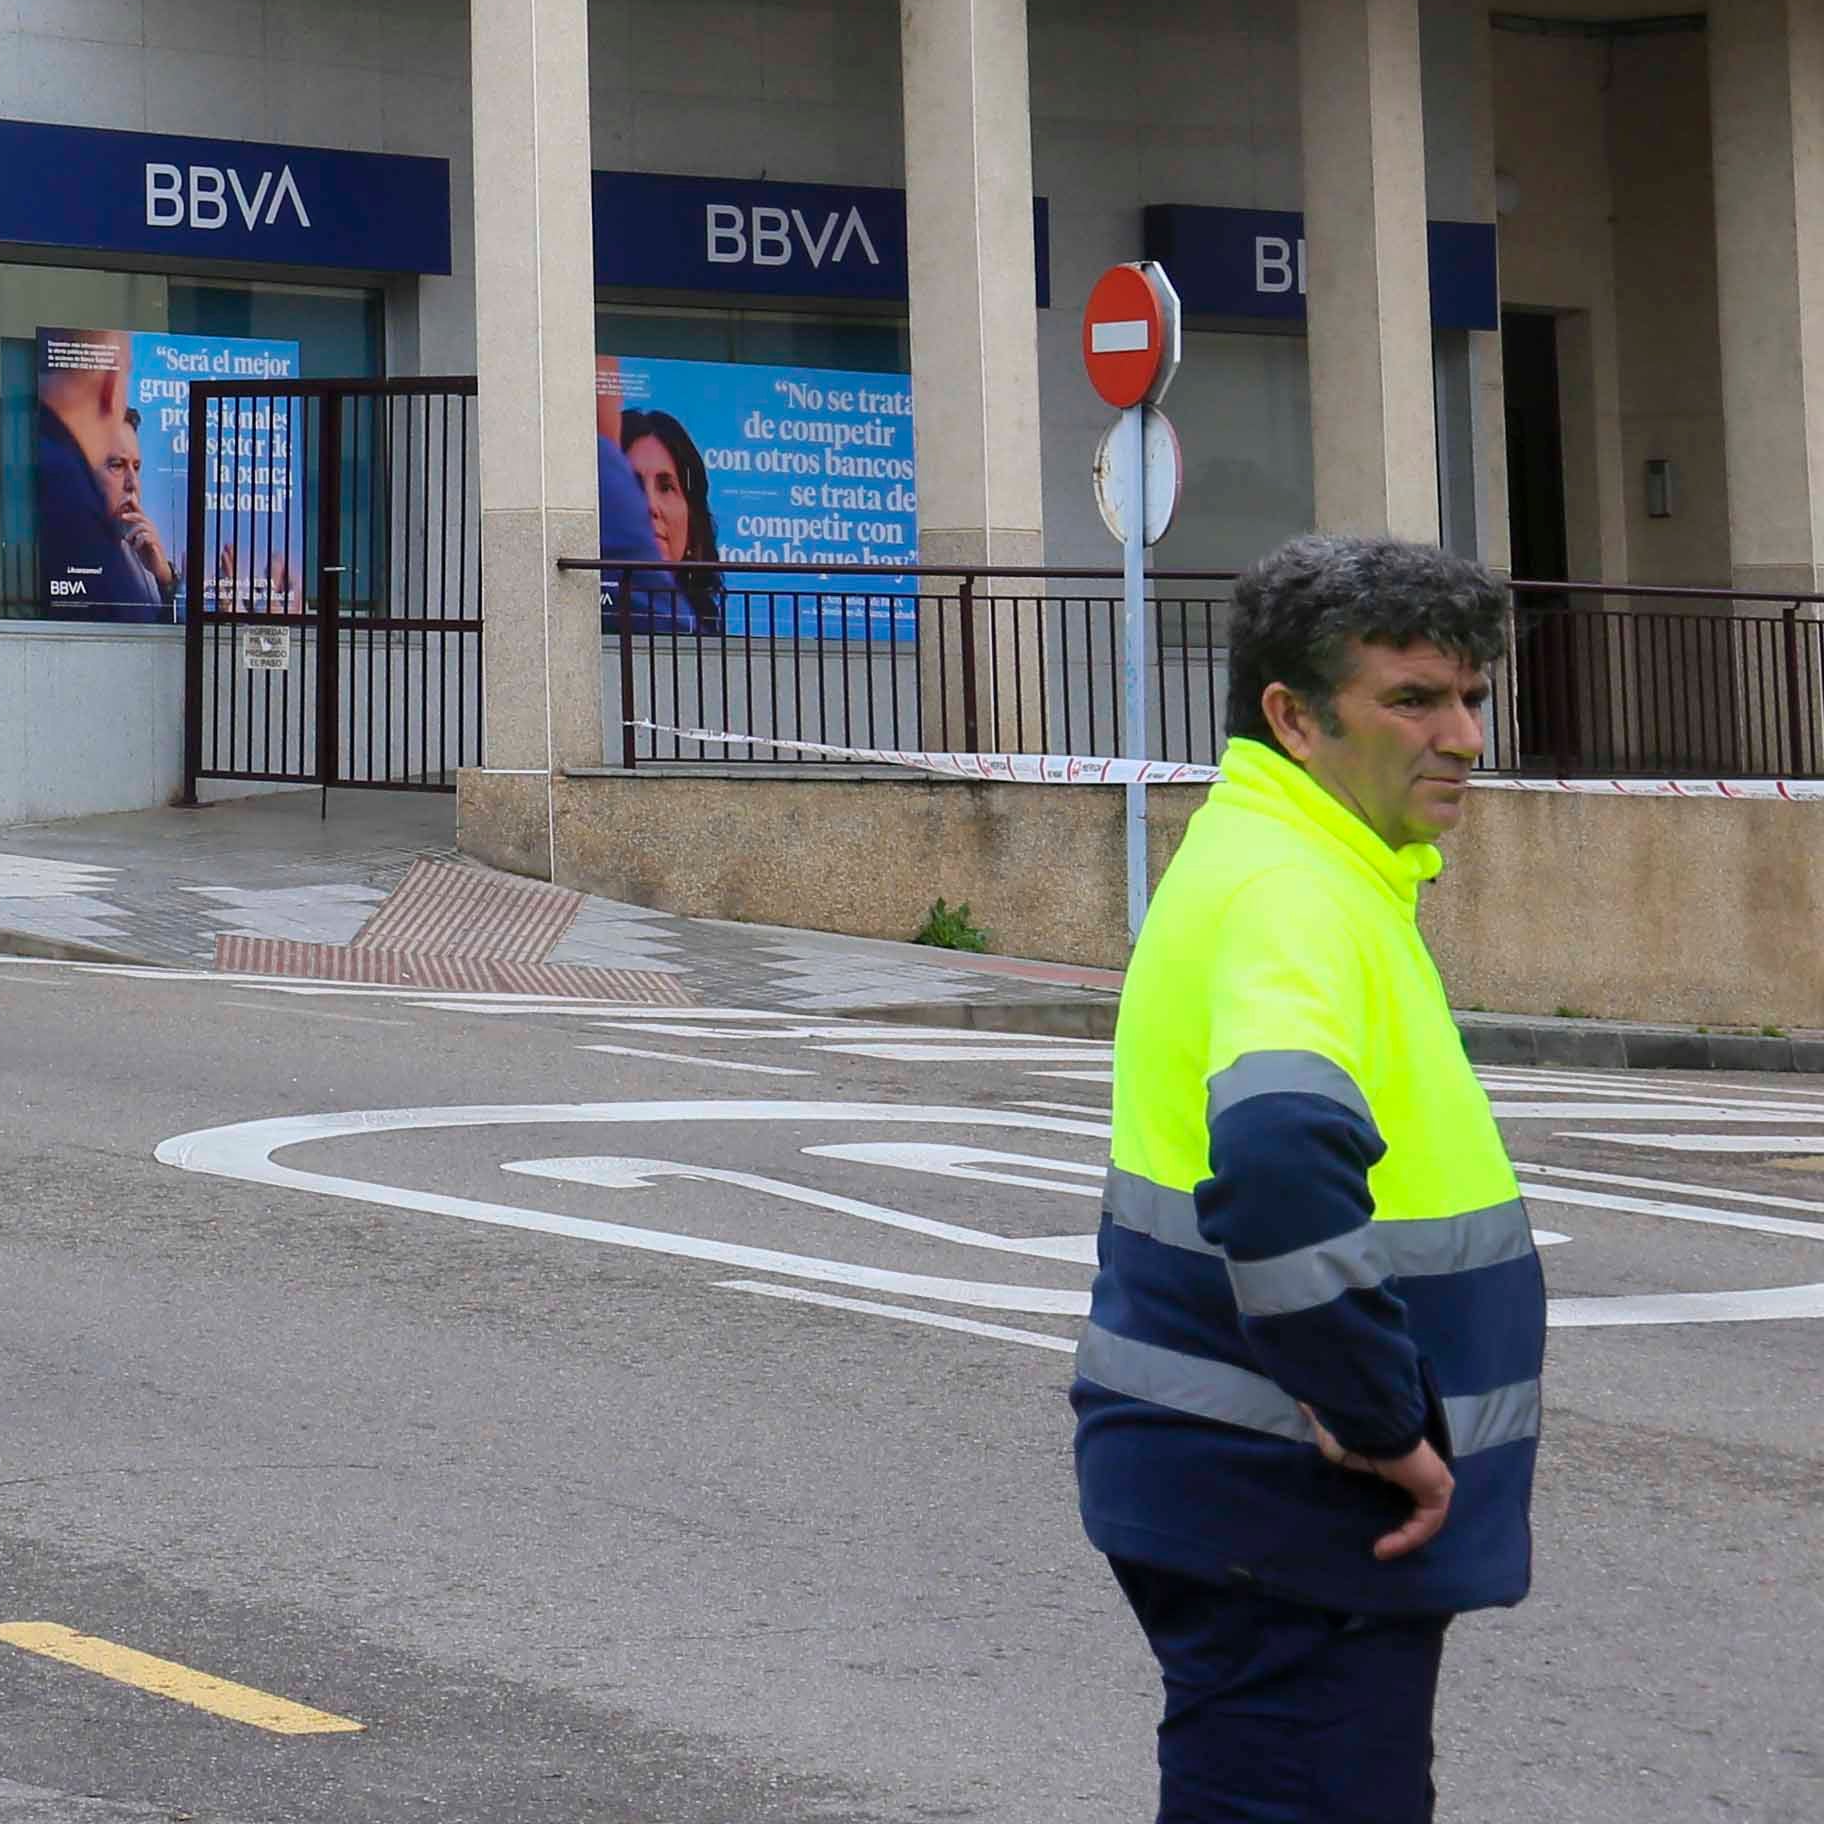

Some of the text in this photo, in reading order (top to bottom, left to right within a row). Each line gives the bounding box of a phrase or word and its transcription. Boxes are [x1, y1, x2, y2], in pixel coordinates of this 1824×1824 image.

[146, 163, 311, 231] BBVA
[706, 203, 880, 268] BBVA
[156, 346, 291, 379] “Será el mejor
[775, 380, 912, 416] “No se trata
[744, 411, 896, 450] de competir
[704, 447, 913, 480] con otros bancos
[790, 484, 816, 507] se
[821, 483, 881, 511] trata
[886, 483, 917, 512] de
[737, 513, 904, 545] competir con
[719, 541, 777, 564] todo
[783, 542, 802, 564] lo
[50, 580, 87, 596] BBVA
